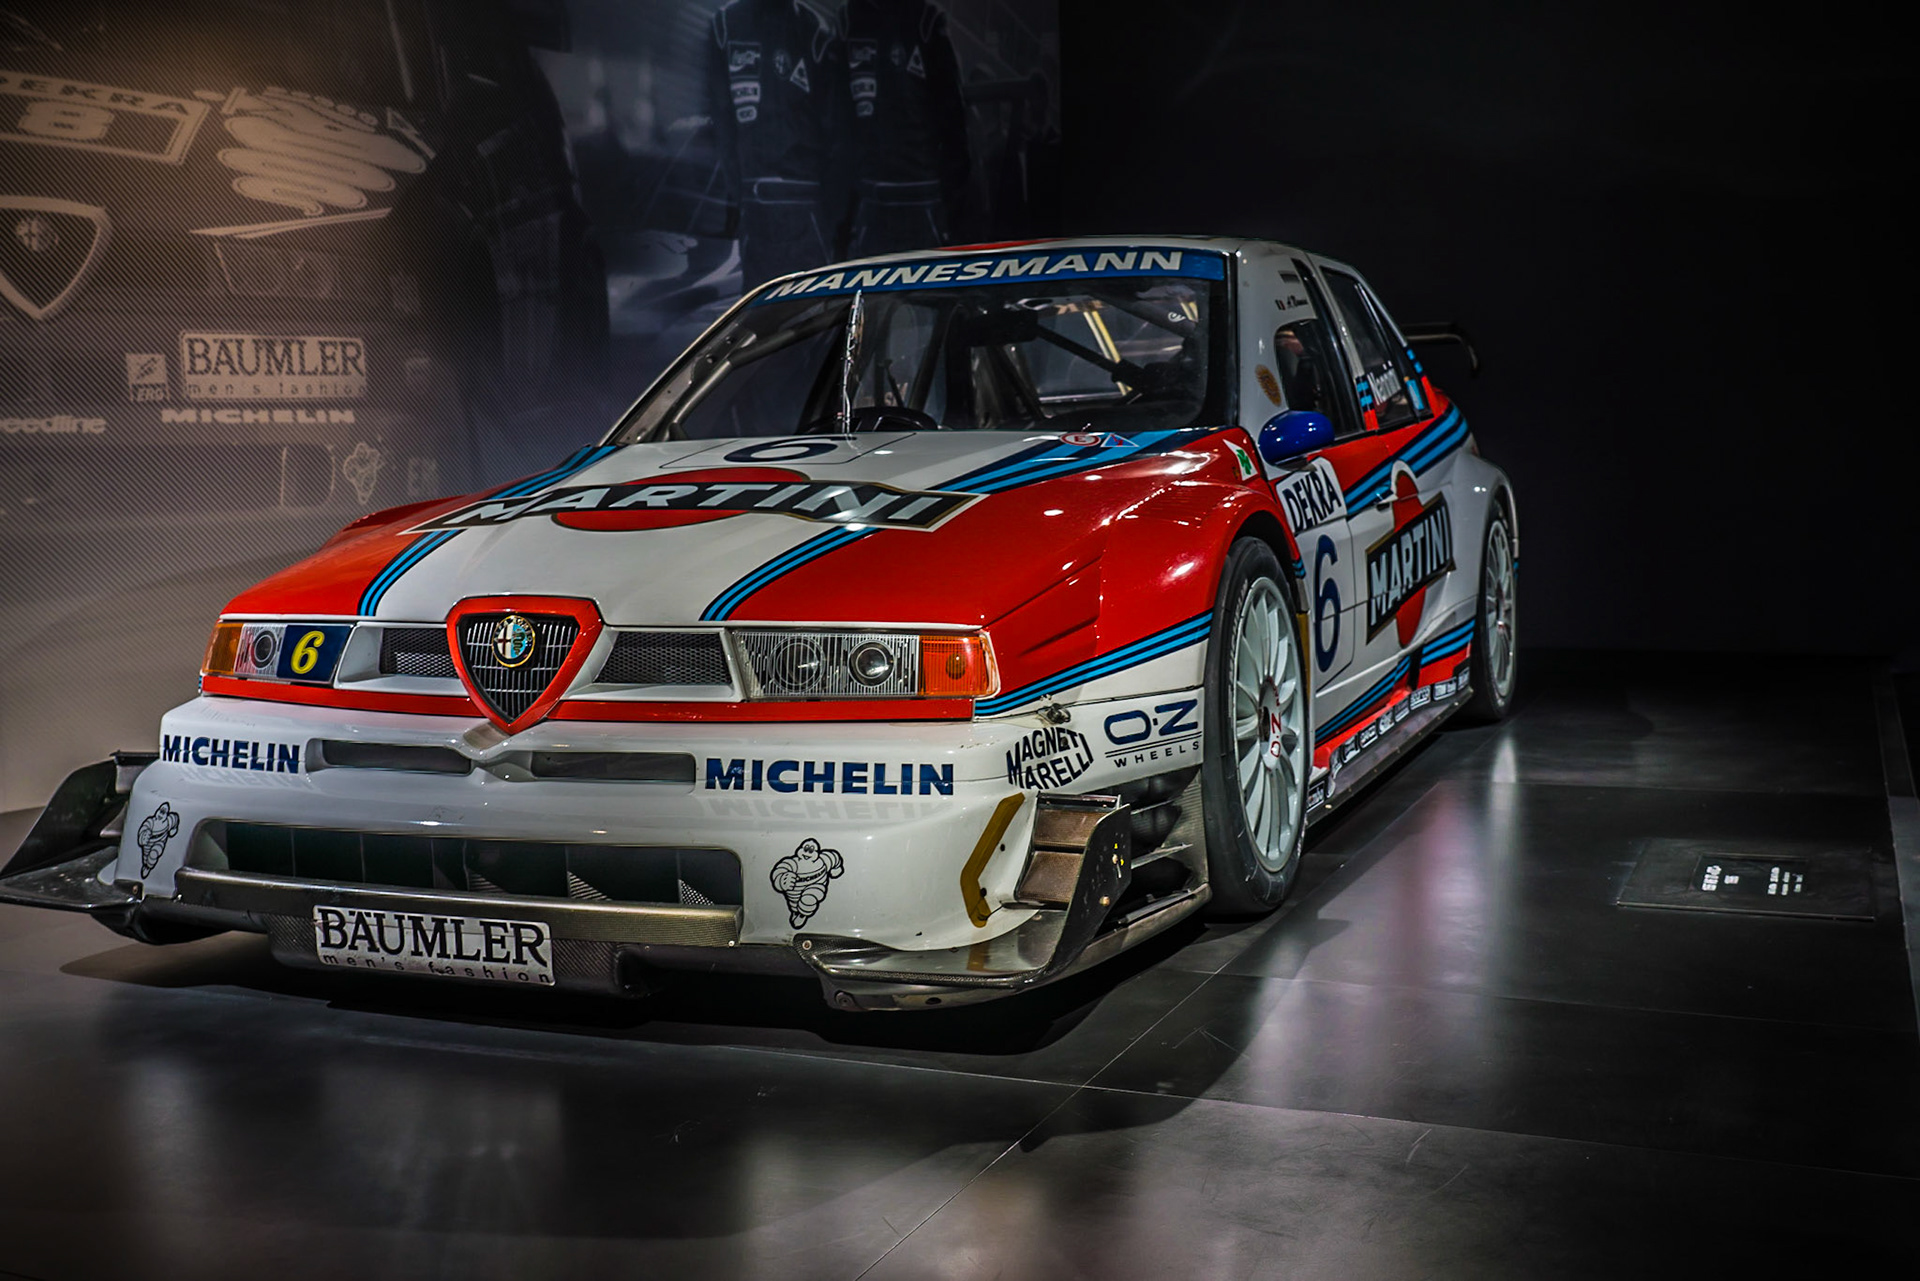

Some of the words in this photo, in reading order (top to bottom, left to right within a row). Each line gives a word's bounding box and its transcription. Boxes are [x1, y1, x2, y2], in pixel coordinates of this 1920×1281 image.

[765, 251, 1183, 300] MANNESMANN
[161, 408, 355, 424] MICHELIN
[723, 437, 869, 463] 6
[448, 482, 944, 523] MARTINI
[1282, 471, 1342, 532] DEKRA
[1370, 505, 1450, 627] MARTINI
[1313, 534, 1341, 673] 6
[291, 630, 325, 675] 6
[162, 734, 300, 774] MICHELIN
[1006, 727, 1094, 767] MAGNETI
[1114, 740, 1200, 768] WHEELS
[705, 758, 954, 796] MICHELIN
[1006, 752, 1094, 790] MARELLI
[317, 908, 548, 967] BÄUMLER
[323, 953, 405, 971] men's
[428, 961, 556, 984] fashion
